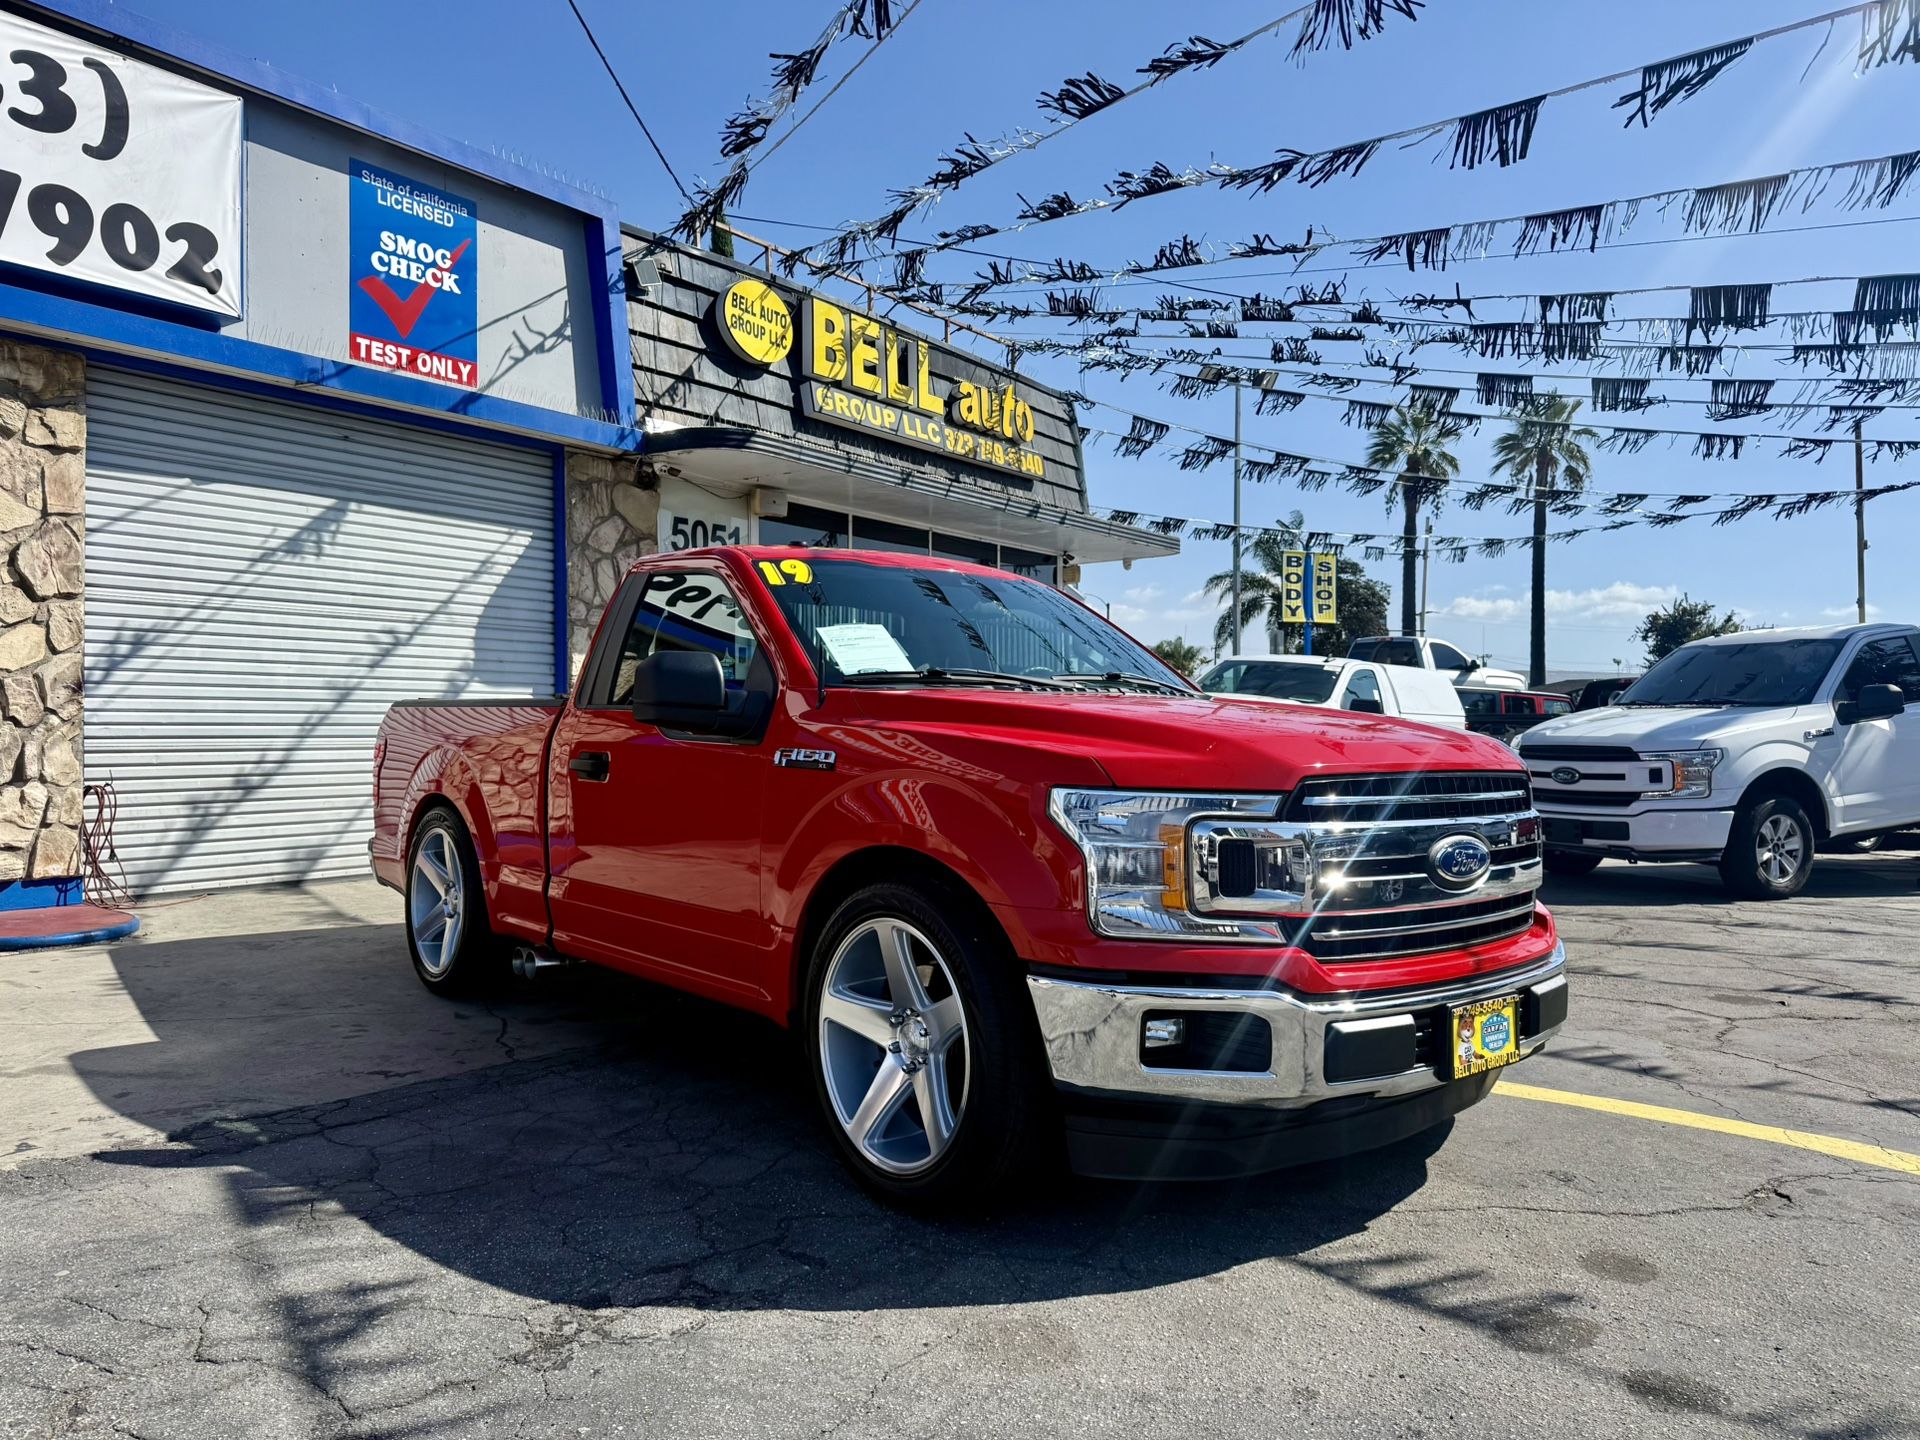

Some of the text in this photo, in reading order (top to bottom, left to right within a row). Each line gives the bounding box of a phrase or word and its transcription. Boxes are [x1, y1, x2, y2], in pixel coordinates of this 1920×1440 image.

[0, 49, 130, 161] 3)
[361, 169, 468, 217] State of california
[377, 188, 454, 228] LICENSED
[380, 231, 453, 269] SMOG
[371, 251, 462, 295] CHECK
[730, 313, 788, 351] GROUP LLC
[732, 292, 787, 330] BELL AUTO
[356, 336, 472, 382] TEST ONLY
[812, 297, 1035, 443] BELL auto
[815, 386, 896, 430] GROUP
[903, 414, 942, 444] LLC
[671, 516, 741, 551] 5051
[759, 559, 813, 586] 19
[1284, 556, 1302, 617] BODY
[1316, 561, 1333, 615] SHOP
[1451, 849, 1481, 873] Ford
[1455, 1050, 1520, 1079] BELL AUTO GROUP LLC
